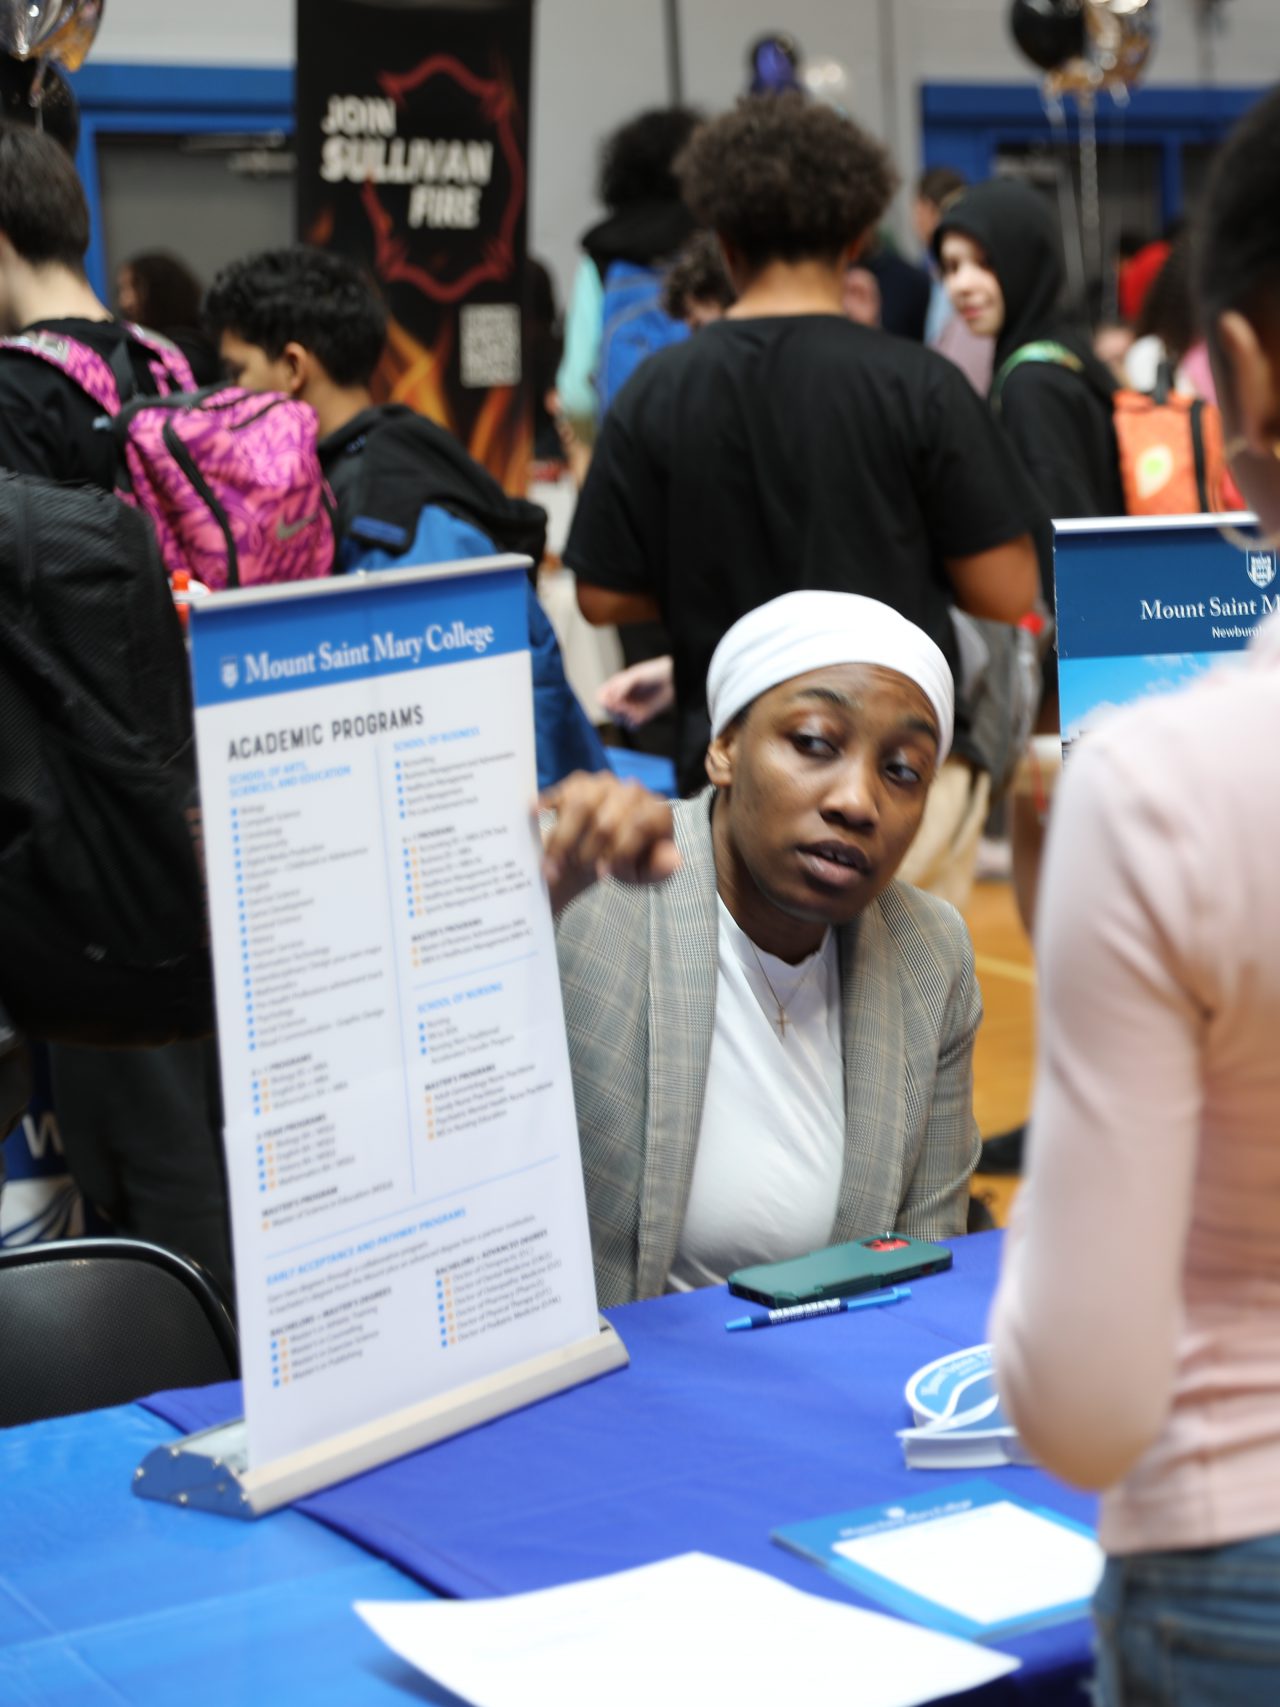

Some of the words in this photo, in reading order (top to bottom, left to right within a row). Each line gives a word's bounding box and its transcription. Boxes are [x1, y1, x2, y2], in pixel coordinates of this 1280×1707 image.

[321, 94, 397, 137] JOIN
[319, 135, 494, 186] SULLIVAN
[408, 185, 482, 229] FIRE
[1139, 599, 1205, 620] Mount
[1209, 596, 1257, 617] Saint
[244, 651, 317, 684] Mount
[318, 641, 371, 671] Saint
[371, 630, 423, 663] Mary
[425, 620, 495, 653] College
[228, 723, 324, 762] ACADEMIC
[331, 704, 424, 742] PROGRAMS
